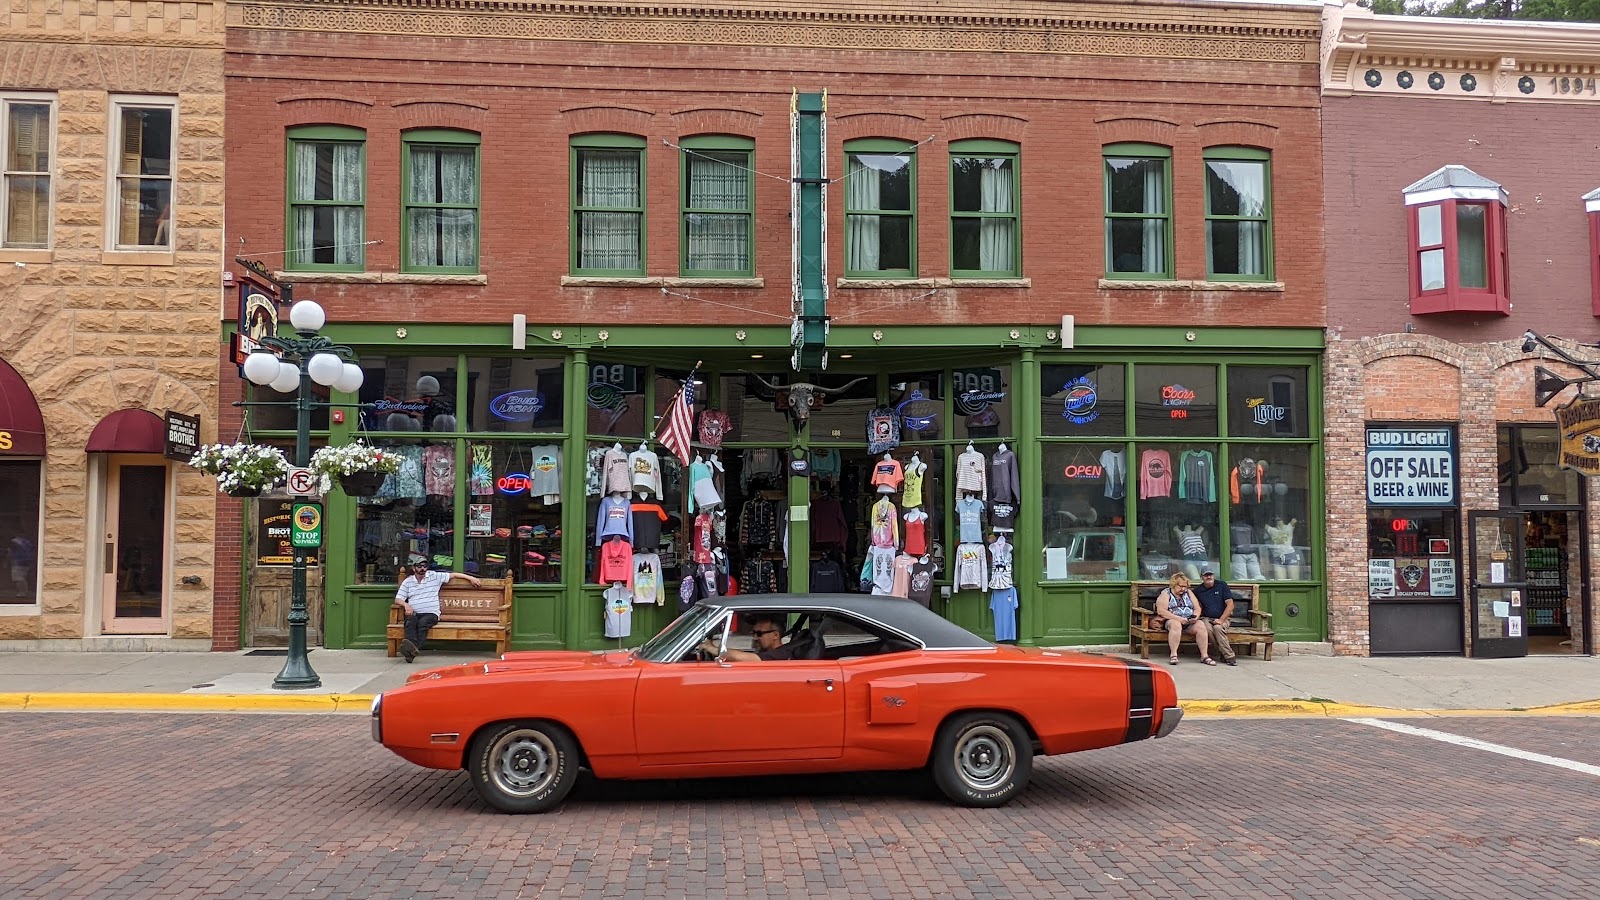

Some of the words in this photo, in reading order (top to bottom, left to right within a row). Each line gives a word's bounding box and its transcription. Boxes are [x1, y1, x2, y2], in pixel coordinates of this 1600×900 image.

[1548, 77, 1596, 96] 1894
[1162, 386, 1195, 399] Coors
[375, 399, 428, 410] Budweiser
[499, 404, 543, 413] LIGHT
[1171, 409, 1187, 419] OPEN
[1253, 404, 1285, 425] Lite
[169, 430, 197, 447] BROTHEL
[1369, 432, 1402, 445] BUD
[1403, 432, 1447, 445] LIGHT
[1065, 465, 1102, 477] OPEN
[1370, 457, 1404, 478] OFF
[1407, 457, 1450, 478] SALE
[498, 477, 532, 489] OPEN
[1373, 482, 1405, 497] BEER
[1407, 485, 1415, 497] &
[1416, 482, 1450, 497] WINE
[268, 527, 291, 535] BROT
[1392, 519, 1419, 531] OPEN
[296, 532, 318, 540] STOP
[536, 788, 553, 801] T/A
[966, 790, 983, 799] T/A
[986, 782, 1015, 799] Radial
